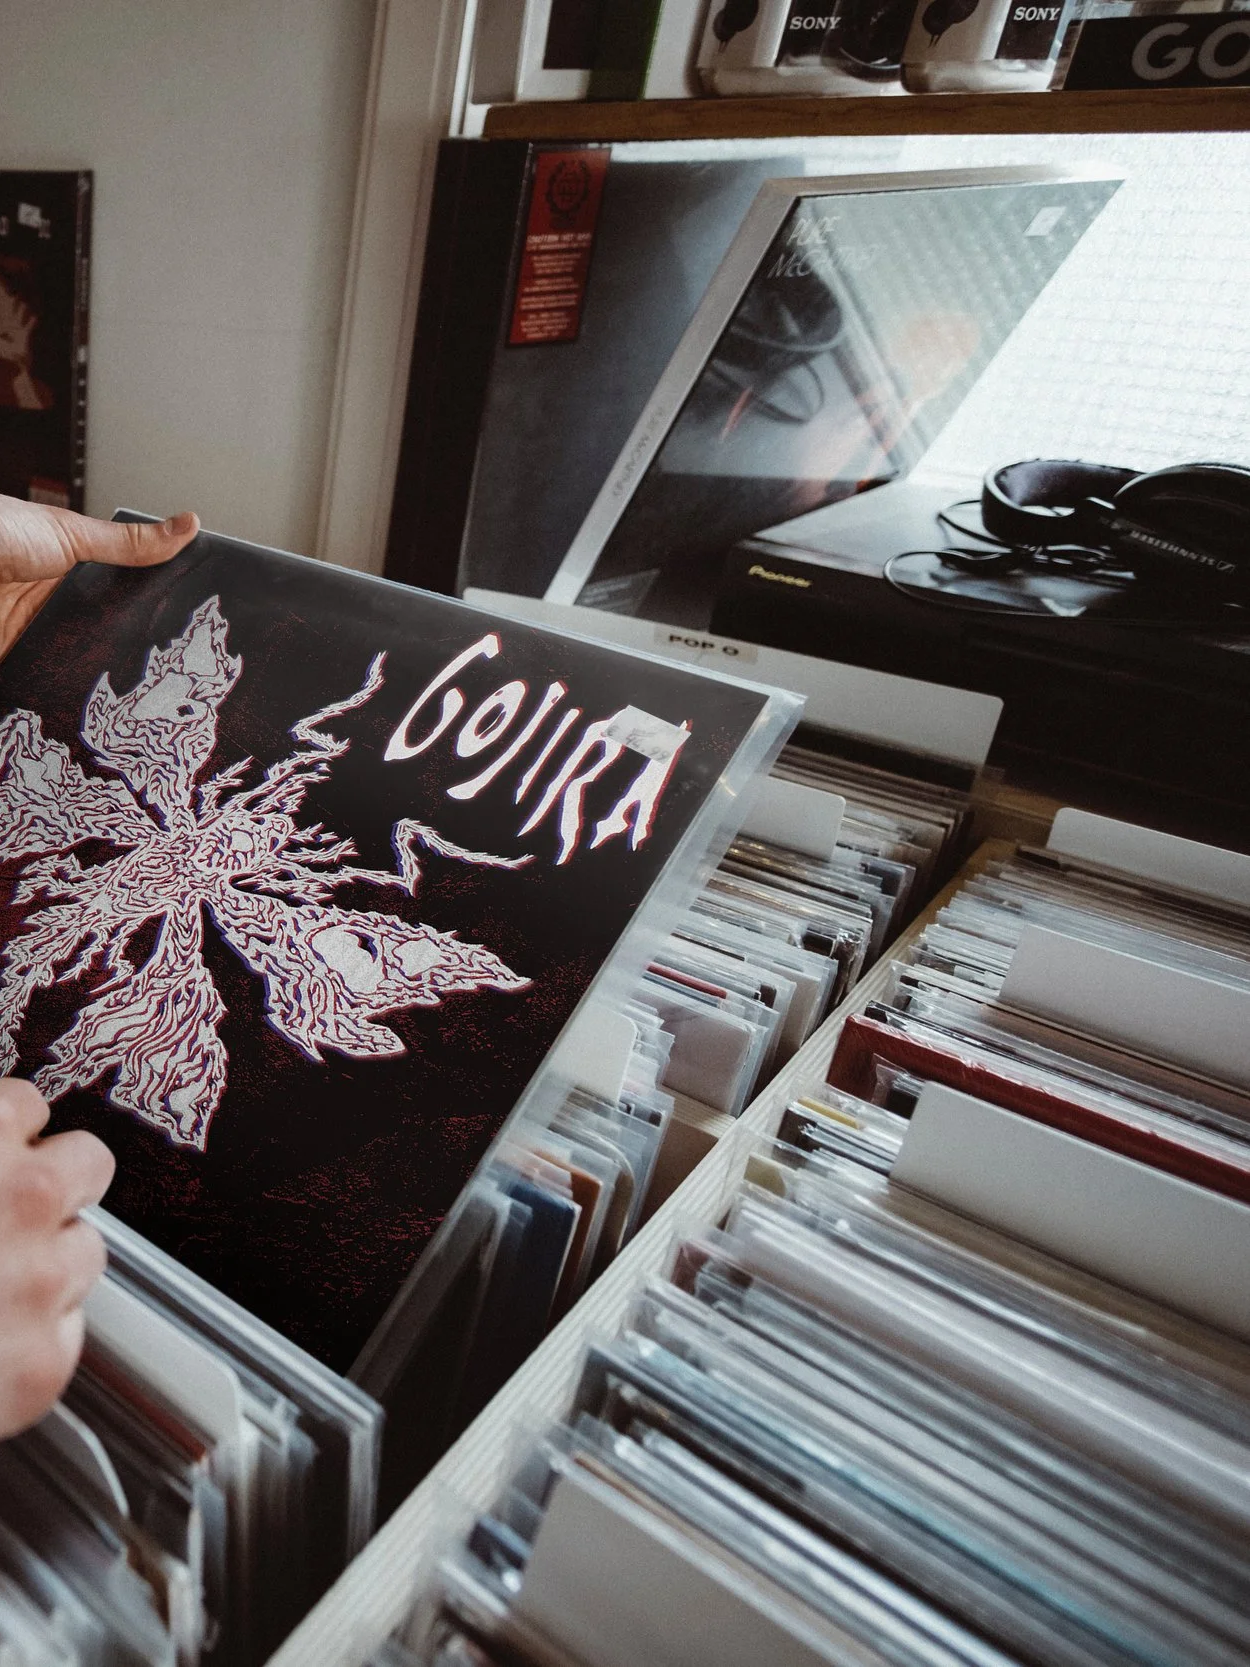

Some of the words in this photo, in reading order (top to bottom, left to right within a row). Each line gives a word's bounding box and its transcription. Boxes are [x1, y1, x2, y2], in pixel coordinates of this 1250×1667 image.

[1013, 7, 1061, 21] SONY
[790, 16, 841, 30] SONY
[1130, 530, 1215, 566] SENNHEISER
[669, 634, 715, 649] POP
[383, 632, 692, 866] GOJIRA
